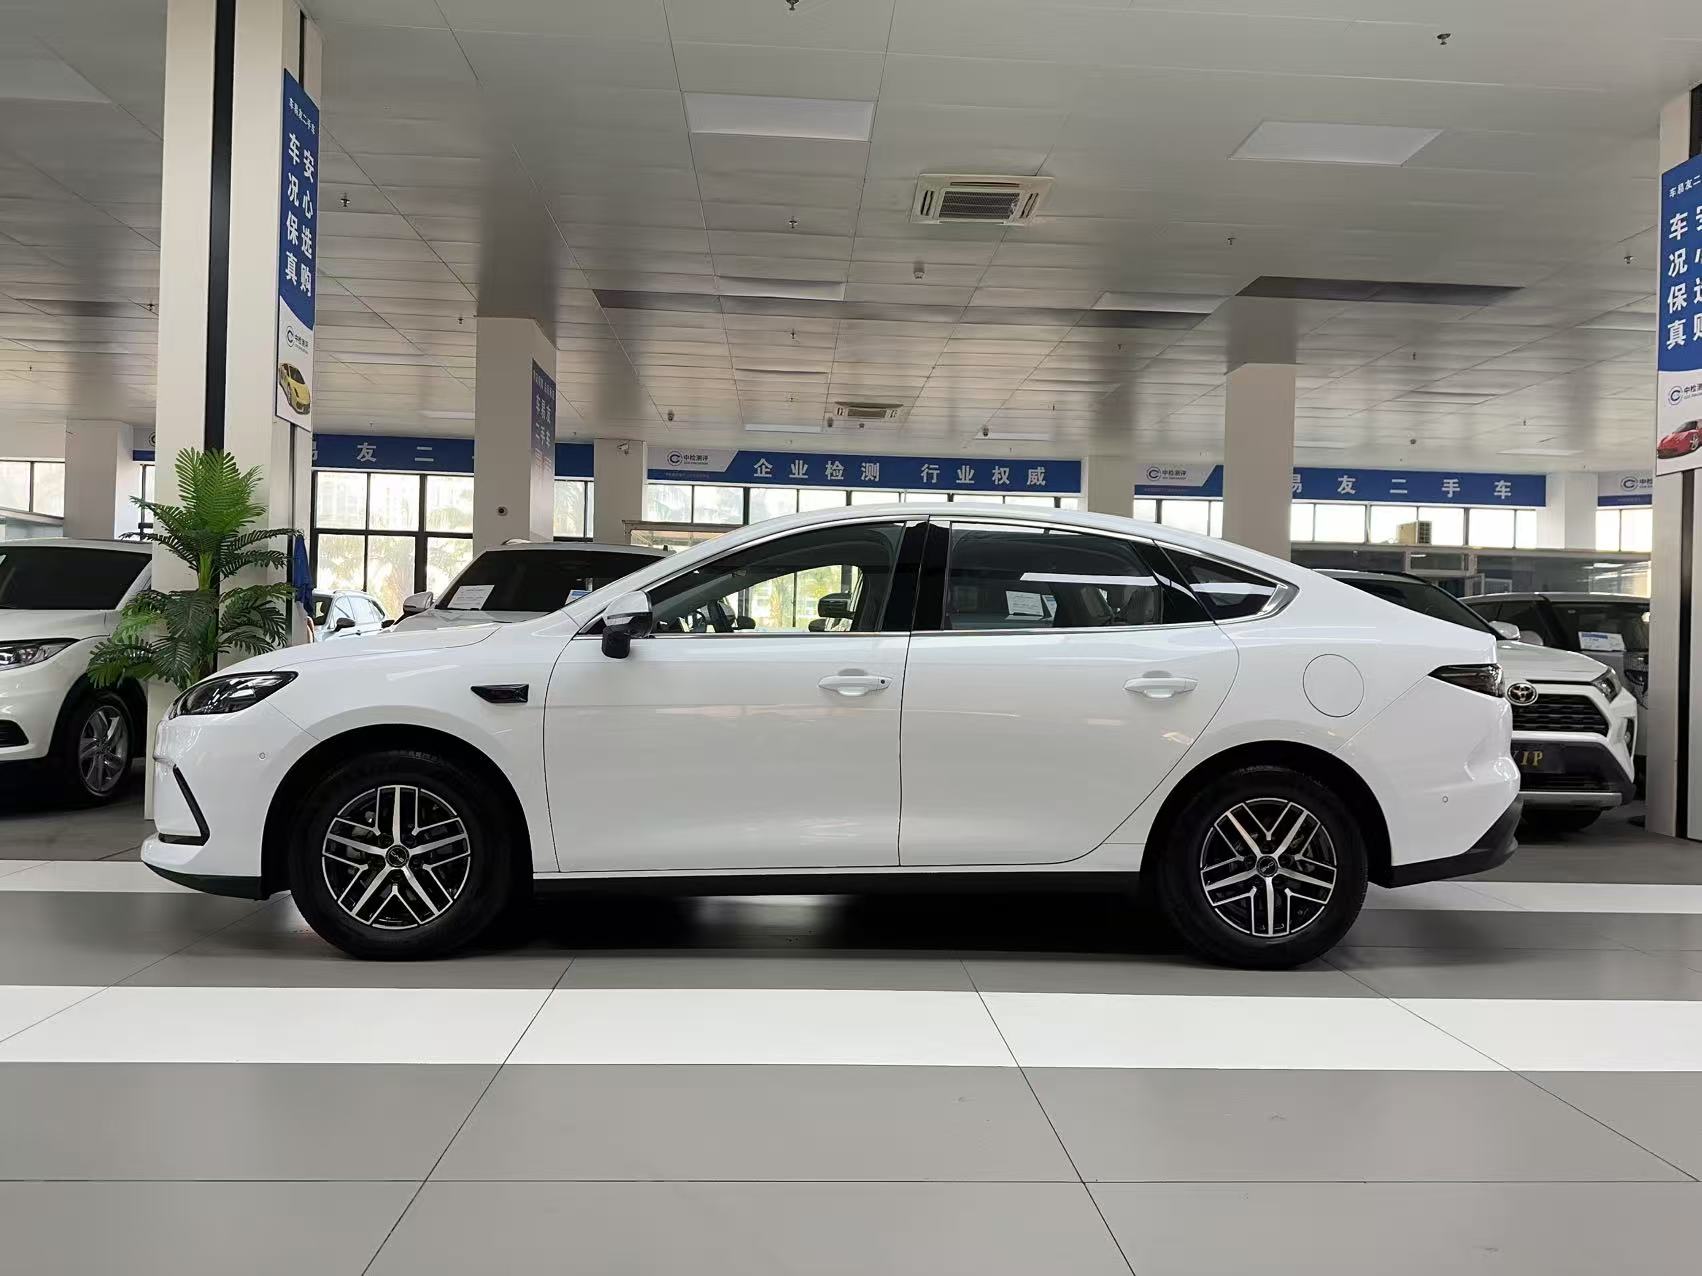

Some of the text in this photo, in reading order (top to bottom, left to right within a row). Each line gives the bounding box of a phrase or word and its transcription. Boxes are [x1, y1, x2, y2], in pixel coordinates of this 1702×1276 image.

[286, 133, 300, 286] 车况保真
[300, 149, 314, 297] 安心选购
[1666, 212, 1688, 350] 车况保真
[753, 458, 1046, 486] 企业检测 行业权威
[1513, 751, 1543, 766] IP
